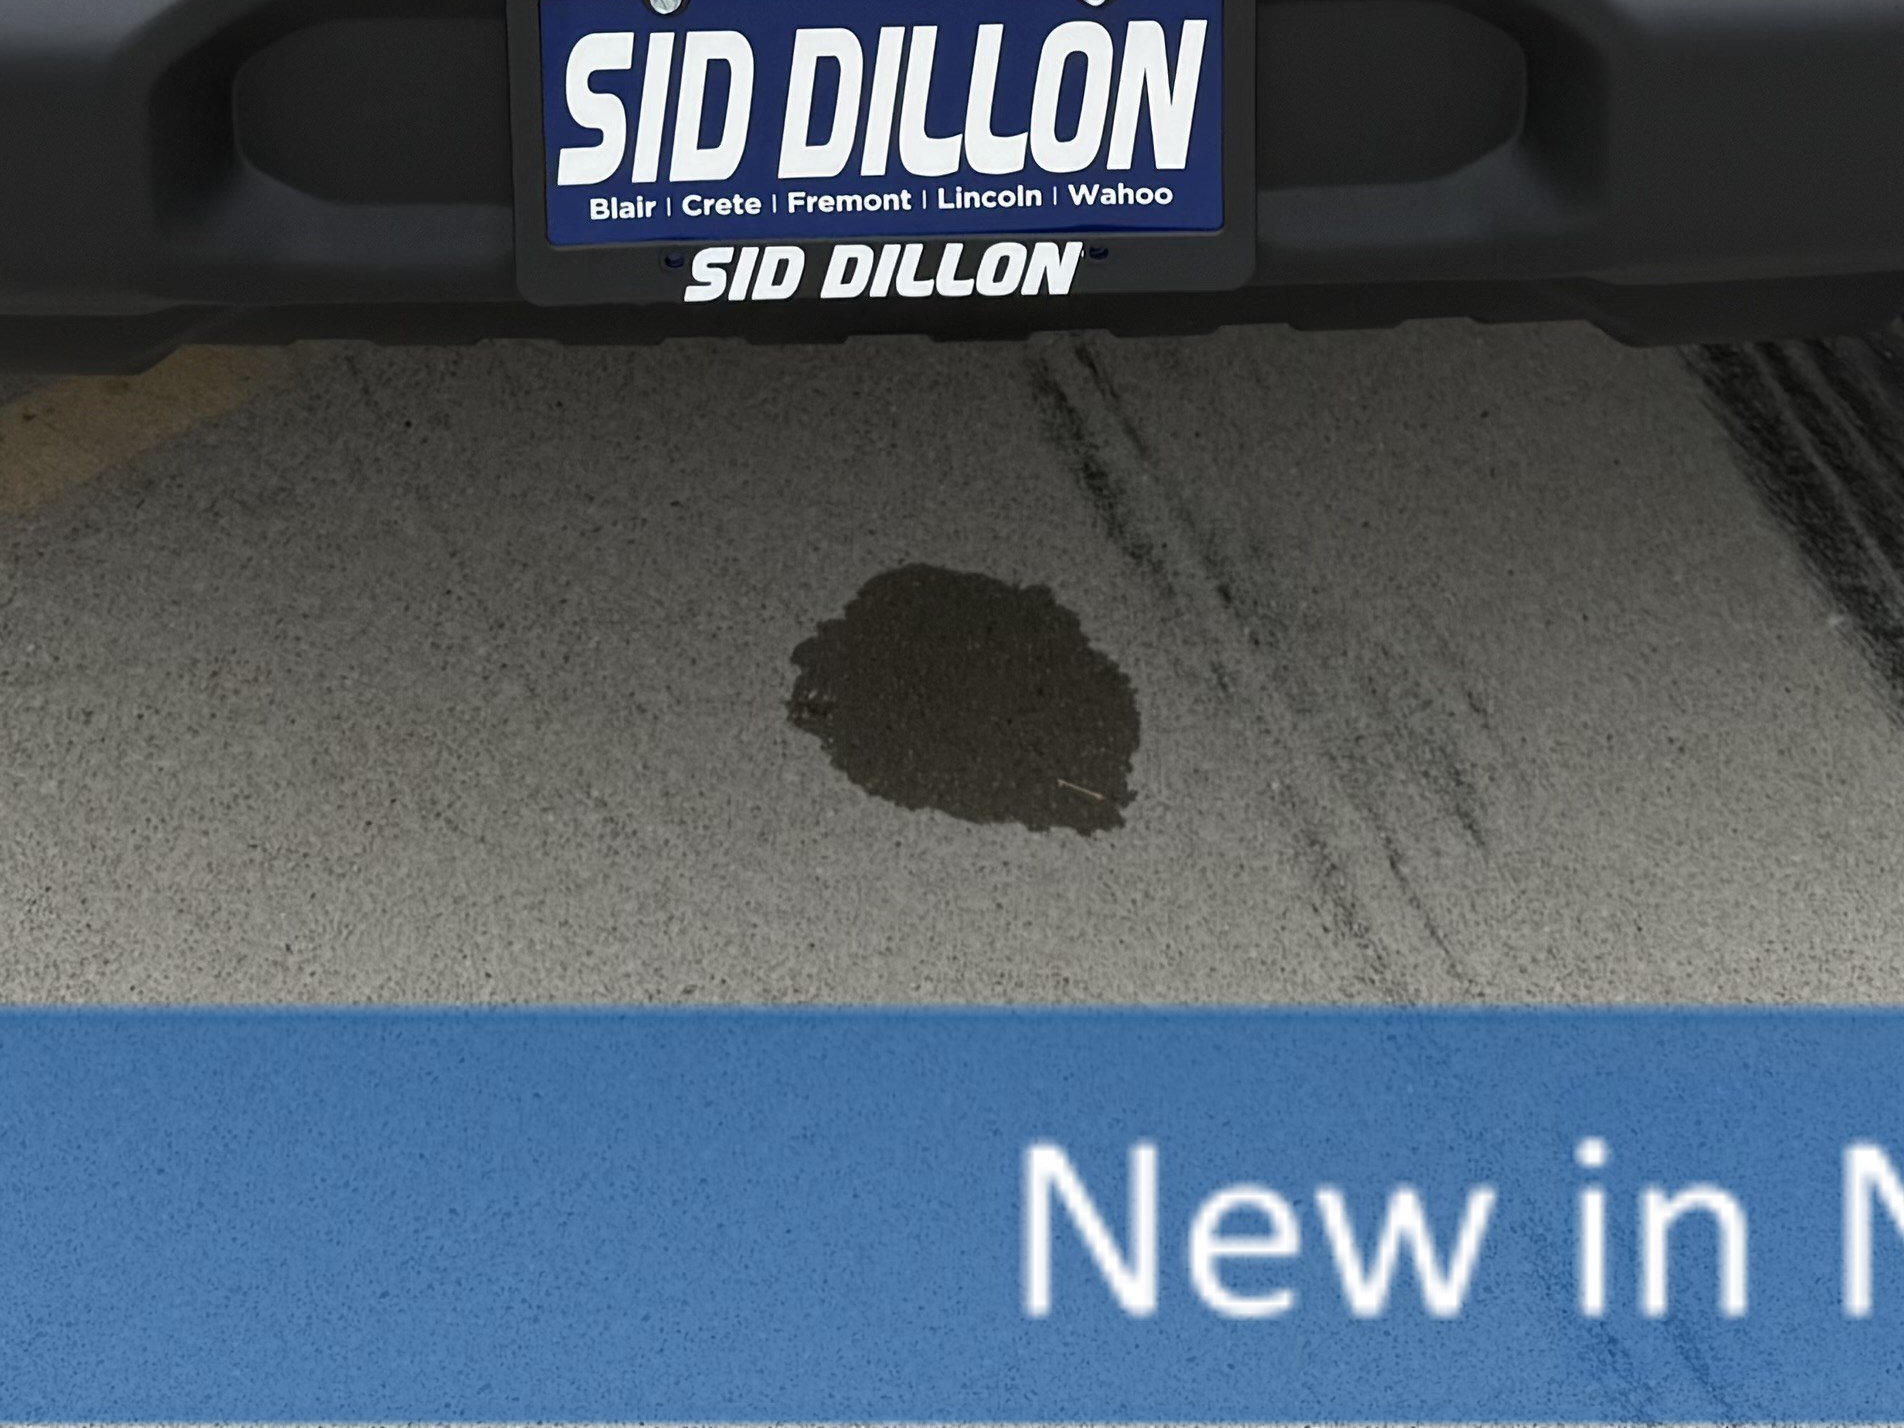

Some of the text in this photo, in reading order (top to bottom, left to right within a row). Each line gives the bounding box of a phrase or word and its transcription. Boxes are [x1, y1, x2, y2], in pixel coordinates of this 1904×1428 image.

[557, 19, 1208, 186] SID DILLON
[589, 182, 1174, 220] Blair Crete Fremont Lincoln Wahoo
[683, 241, 1083, 303] SID DILLON
